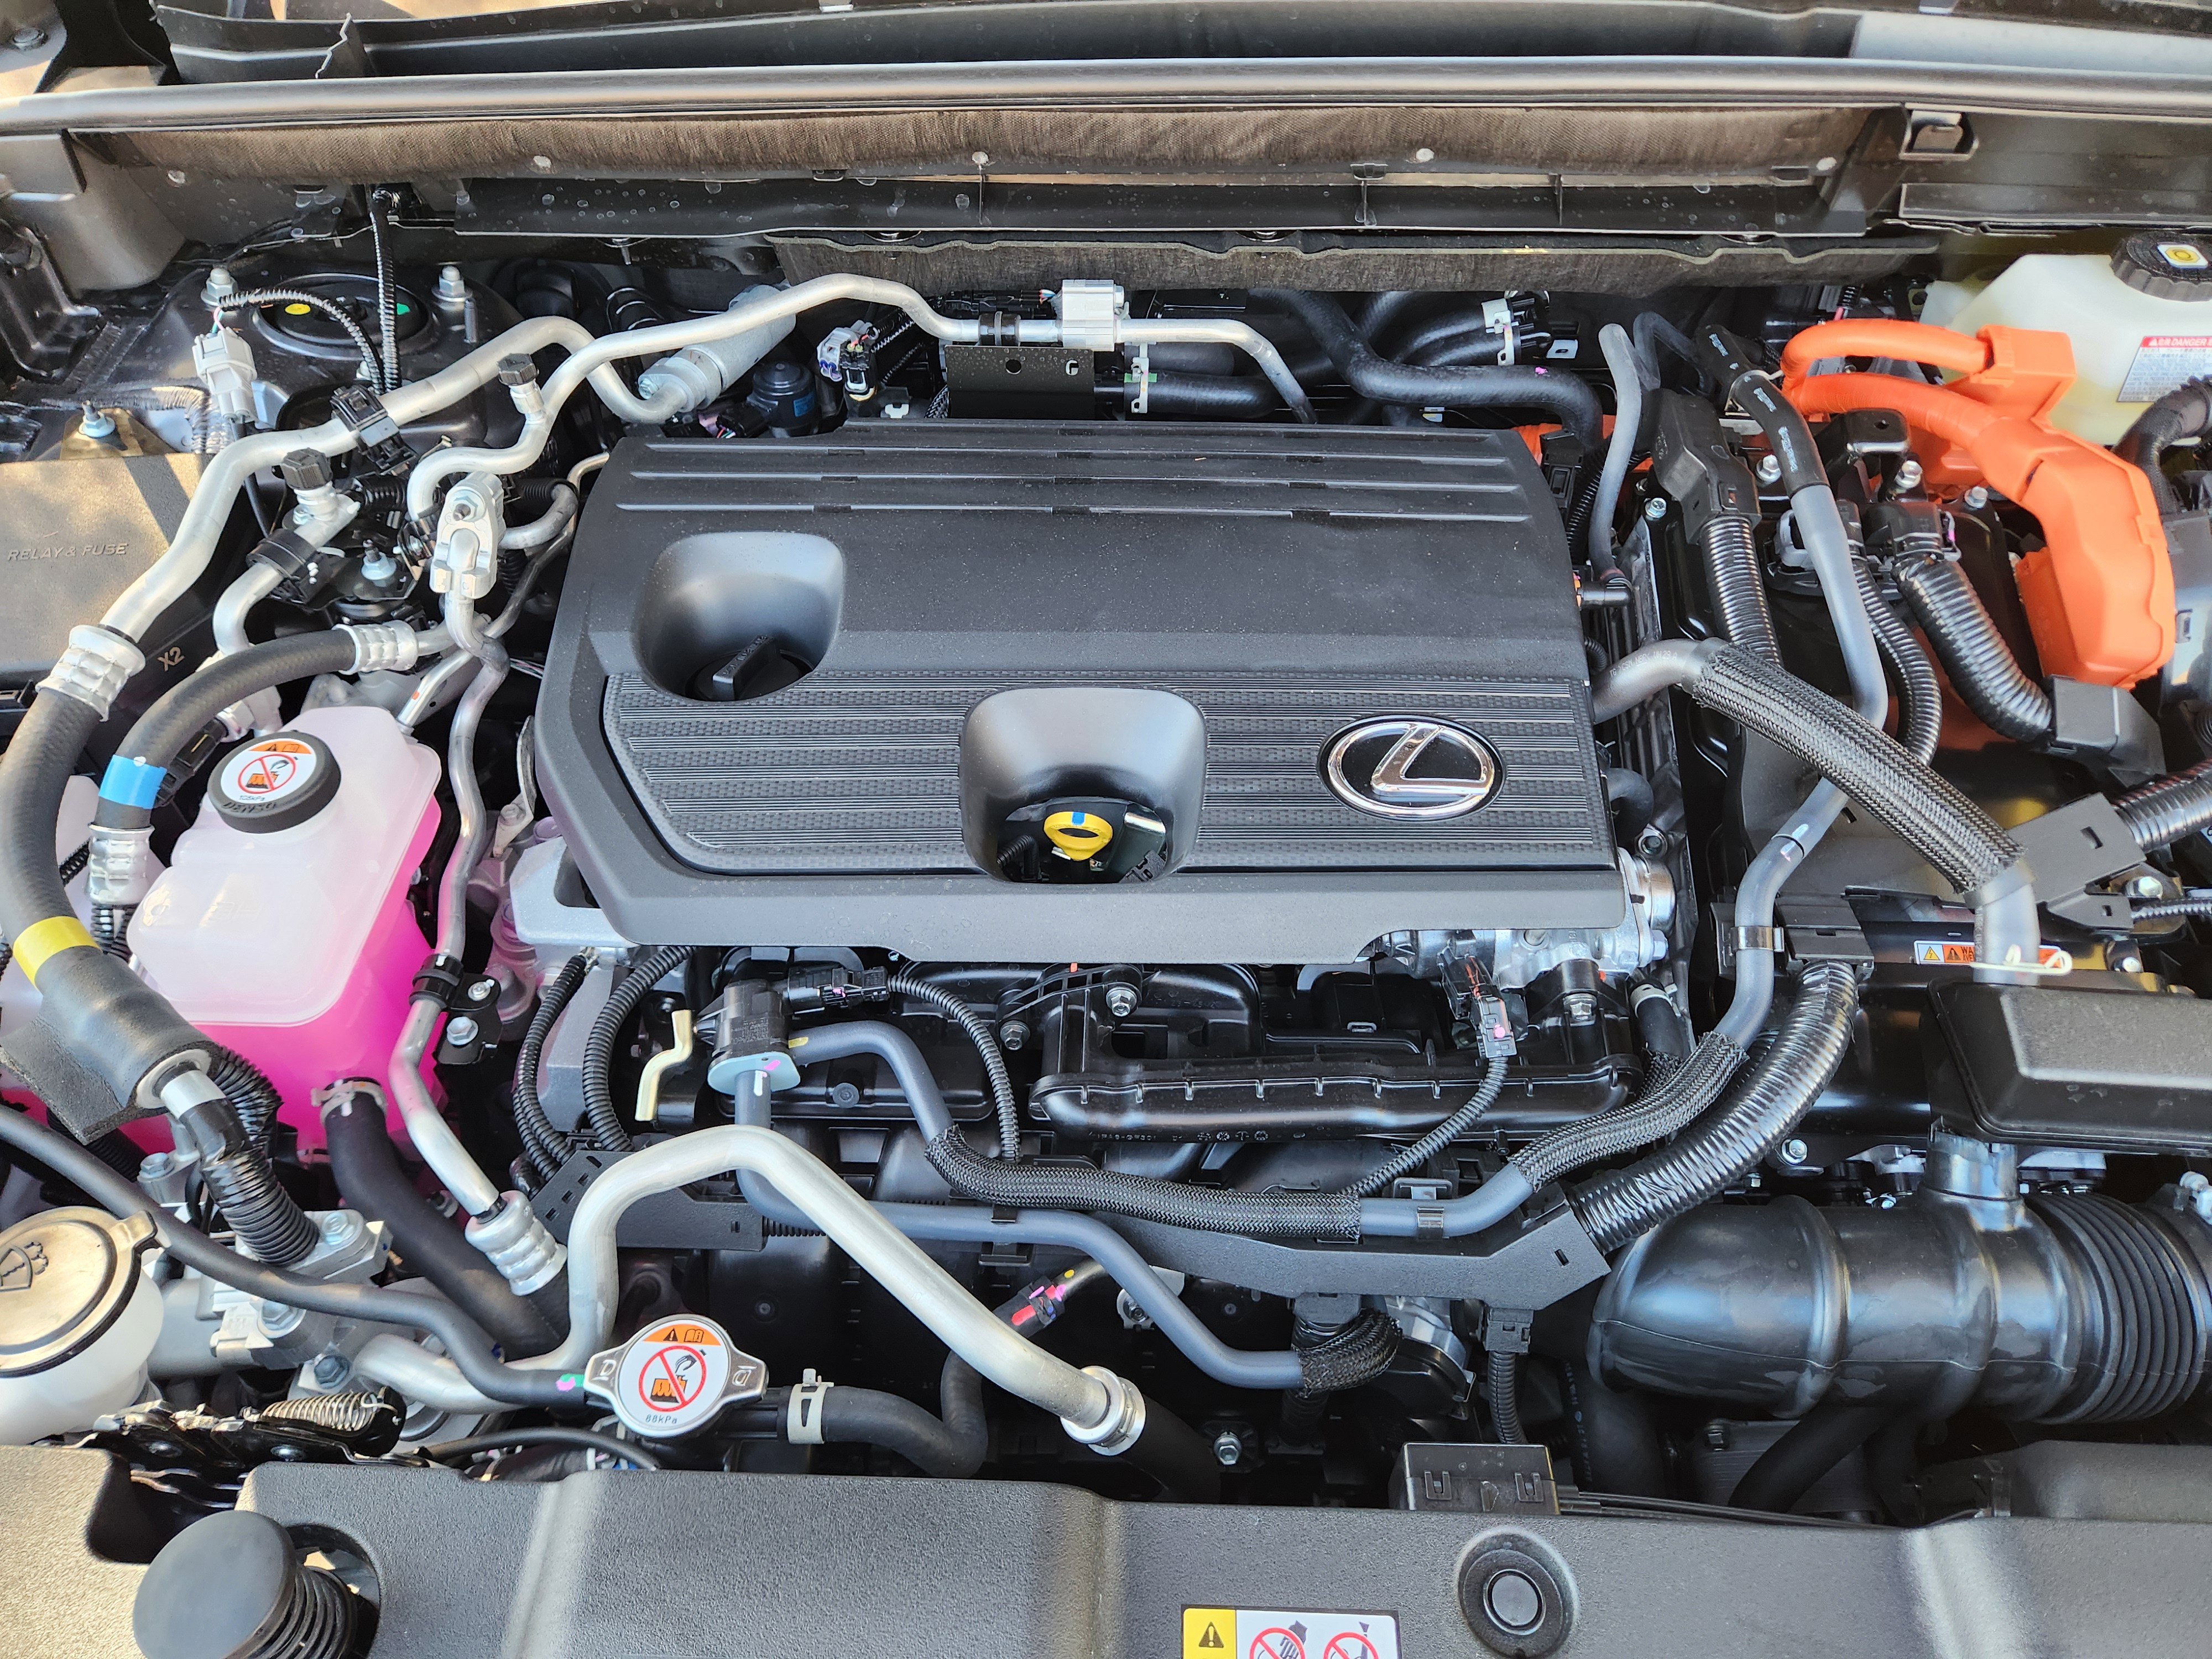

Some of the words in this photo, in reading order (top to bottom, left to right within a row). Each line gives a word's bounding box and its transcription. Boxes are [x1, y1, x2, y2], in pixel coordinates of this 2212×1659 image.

[2171, 338, 2207, 346] DANGER
[7, 546, 64, 561] RELAY
[66, 546, 77, 557] &
[82, 542, 129, 557] FUSE
[157, 646, 185, 672] X2
[645, 1414, 677, 1425] 88kPa
